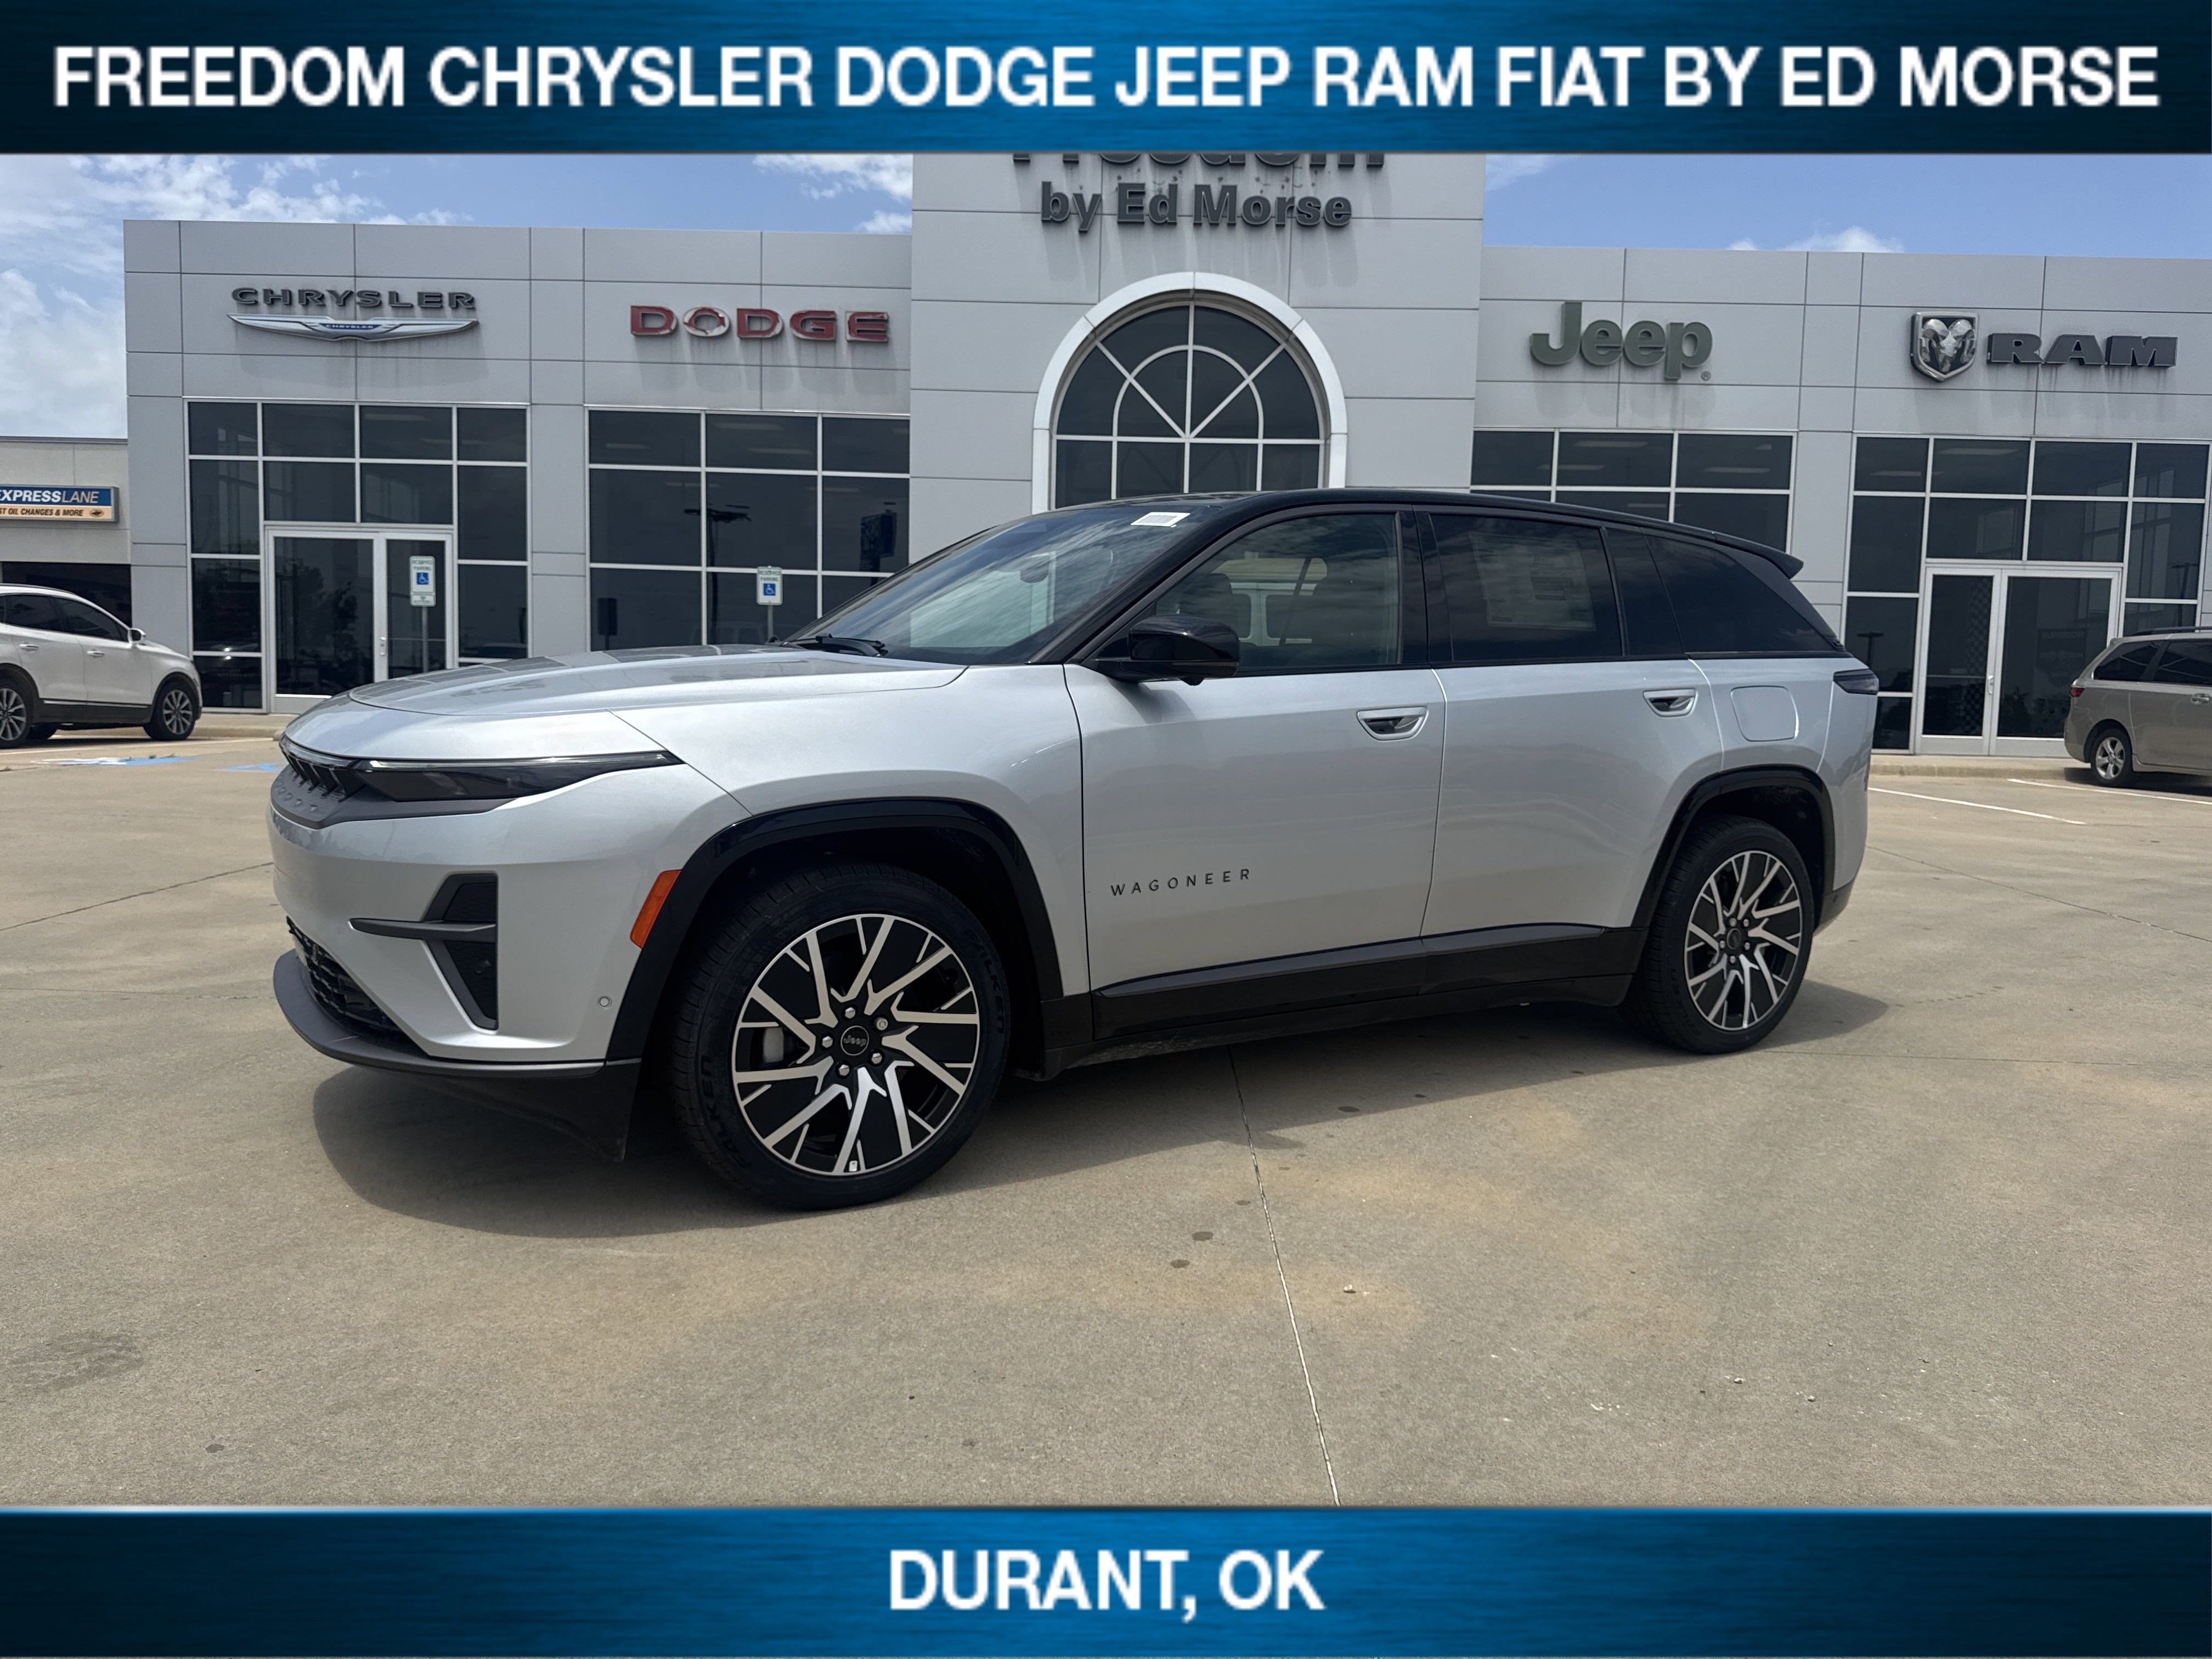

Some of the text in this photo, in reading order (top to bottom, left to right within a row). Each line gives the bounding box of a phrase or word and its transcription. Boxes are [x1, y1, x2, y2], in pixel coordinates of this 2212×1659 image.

[1042, 181, 1352, 233] by Ed Morse
[231, 287, 477, 309] CHRYSLER
[630, 305, 889, 342] DODGE
[1530, 301, 1712, 380] Jeep
[1987, 332, 2177, 368] RAM
[0, 489, 100, 503] XPRESSLANE
[1110, 869, 1249, 896] WAGONEER
[843, 1035, 867, 1047] Jeep
